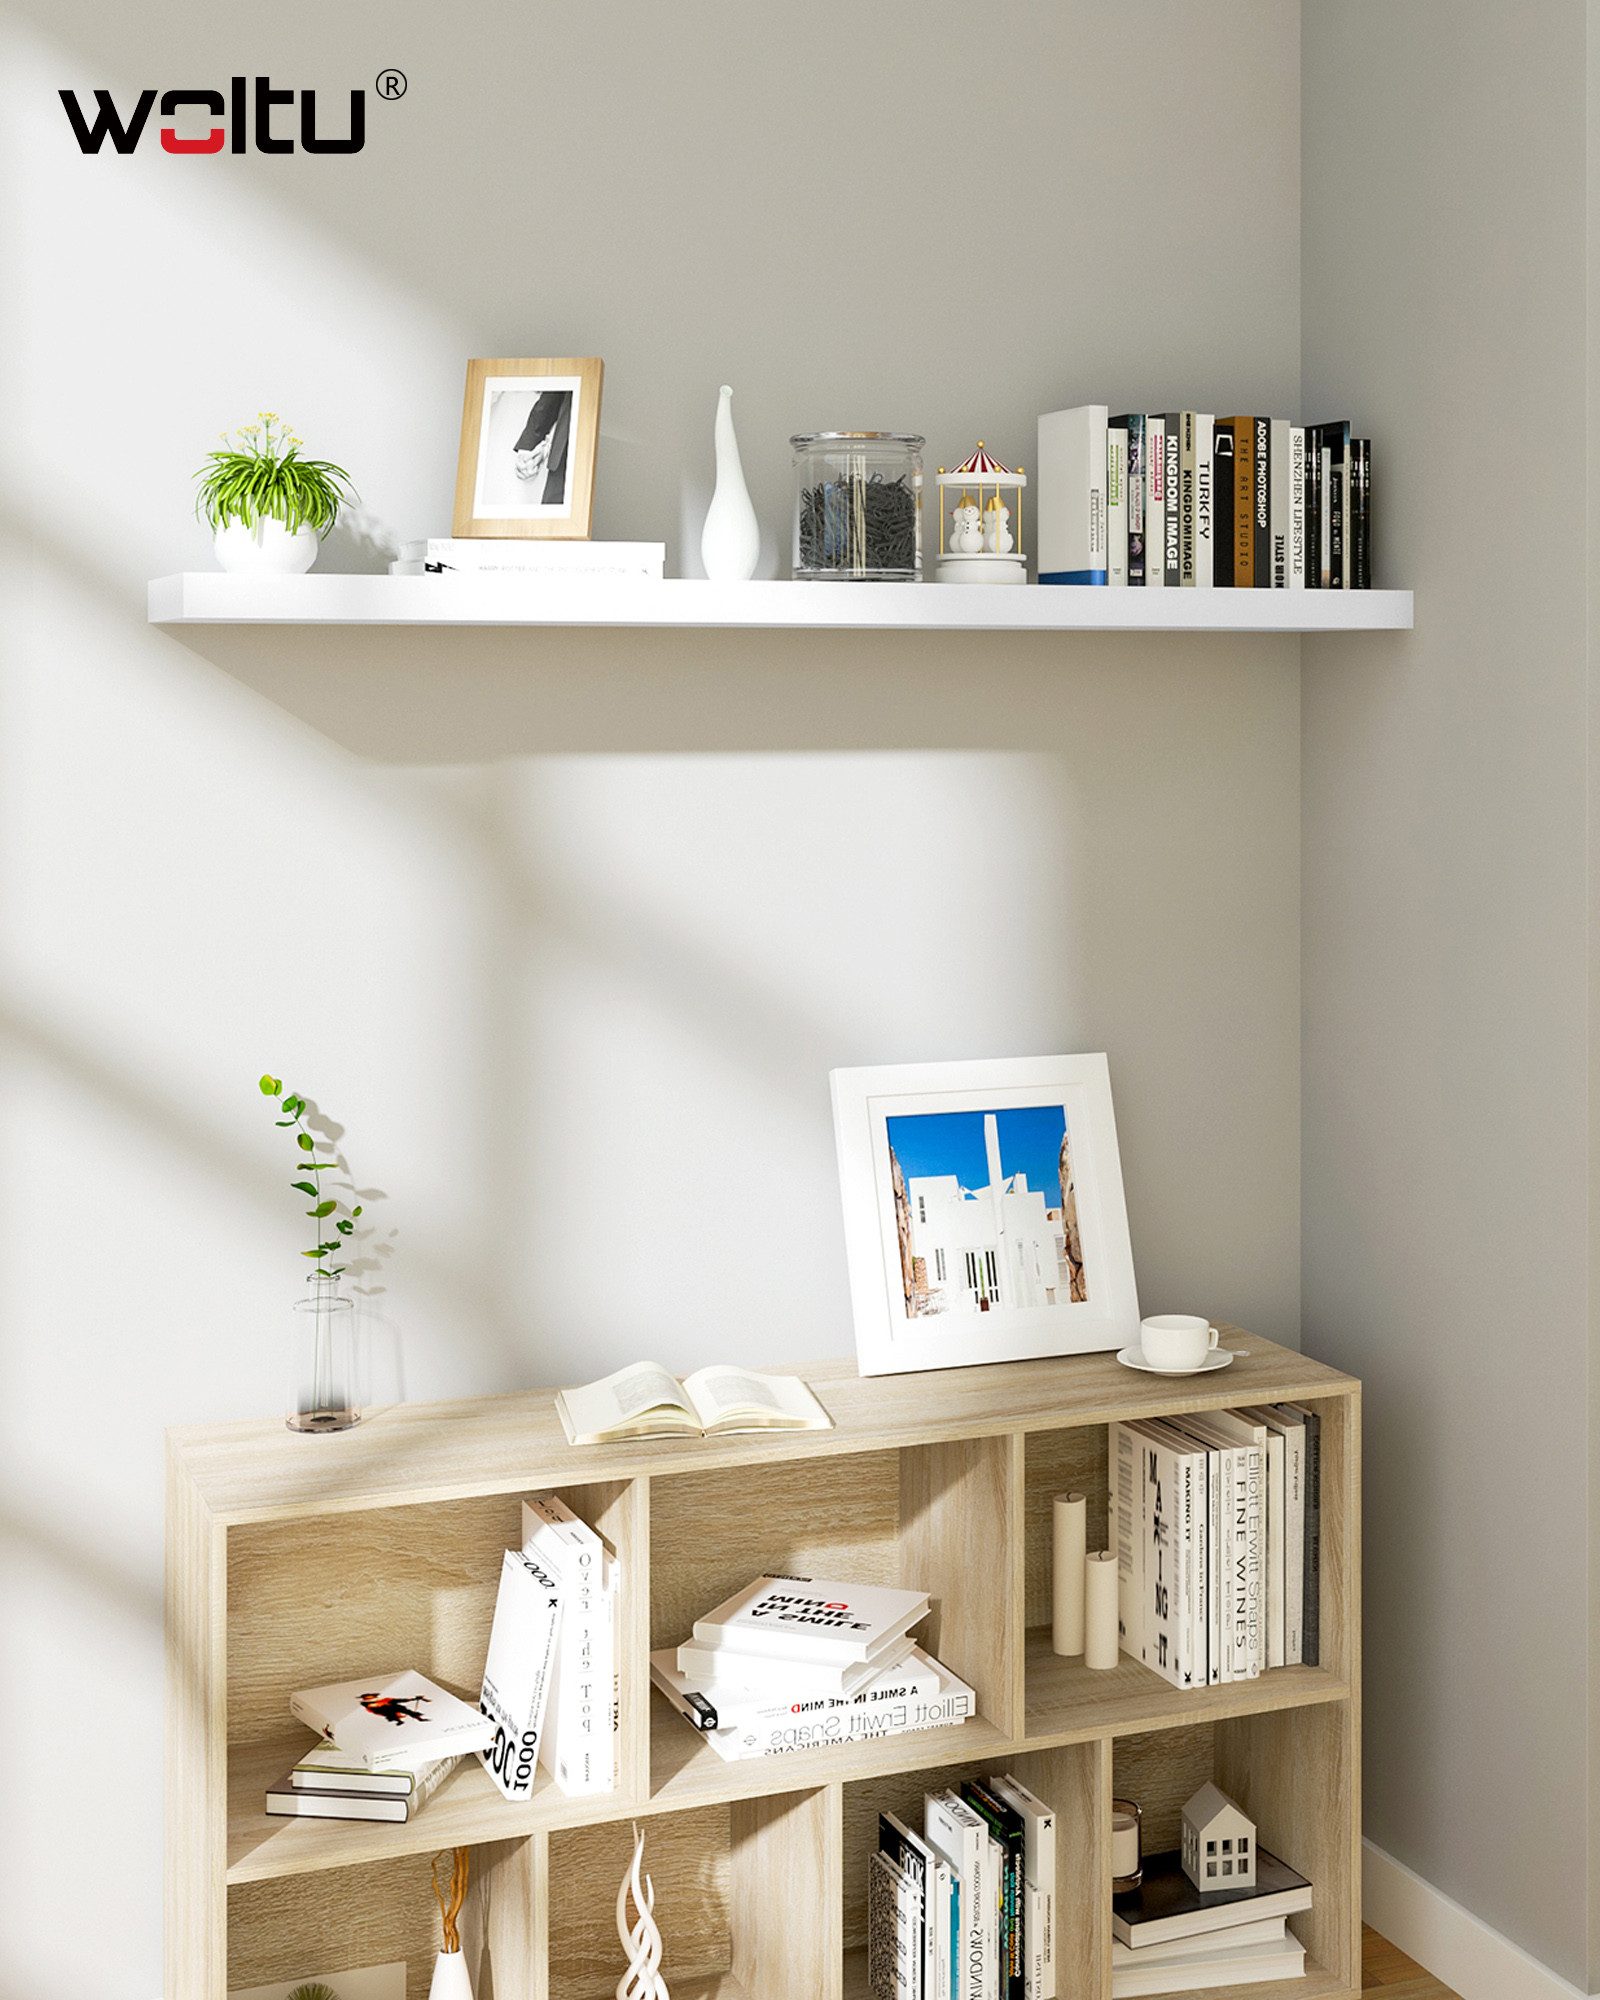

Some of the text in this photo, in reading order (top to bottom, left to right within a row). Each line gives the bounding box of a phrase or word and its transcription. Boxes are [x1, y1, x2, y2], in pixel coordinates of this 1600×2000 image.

[1166, 435, 1178, 570] KINGDOM IMAGE
[1240, 438, 1249, 567] THE ART STUDIO
[1257, 420, 1267, 528] ADOBE PHOTOSHOP
[1293, 435, 1303, 575] SHENZHEN LIFESTYLE
[1275, 534, 1285, 589] NOIR STYLE
[1248, 1452, 1260, 1507] Elliott
[1185, 1528, 1191, 1542] IT
[1236, 1481, 1246, 1648] FINE WINES
[1248, 1516, 1260, 1574] Erwitt
[1247, 1581, 1260, 1650] Snaps
